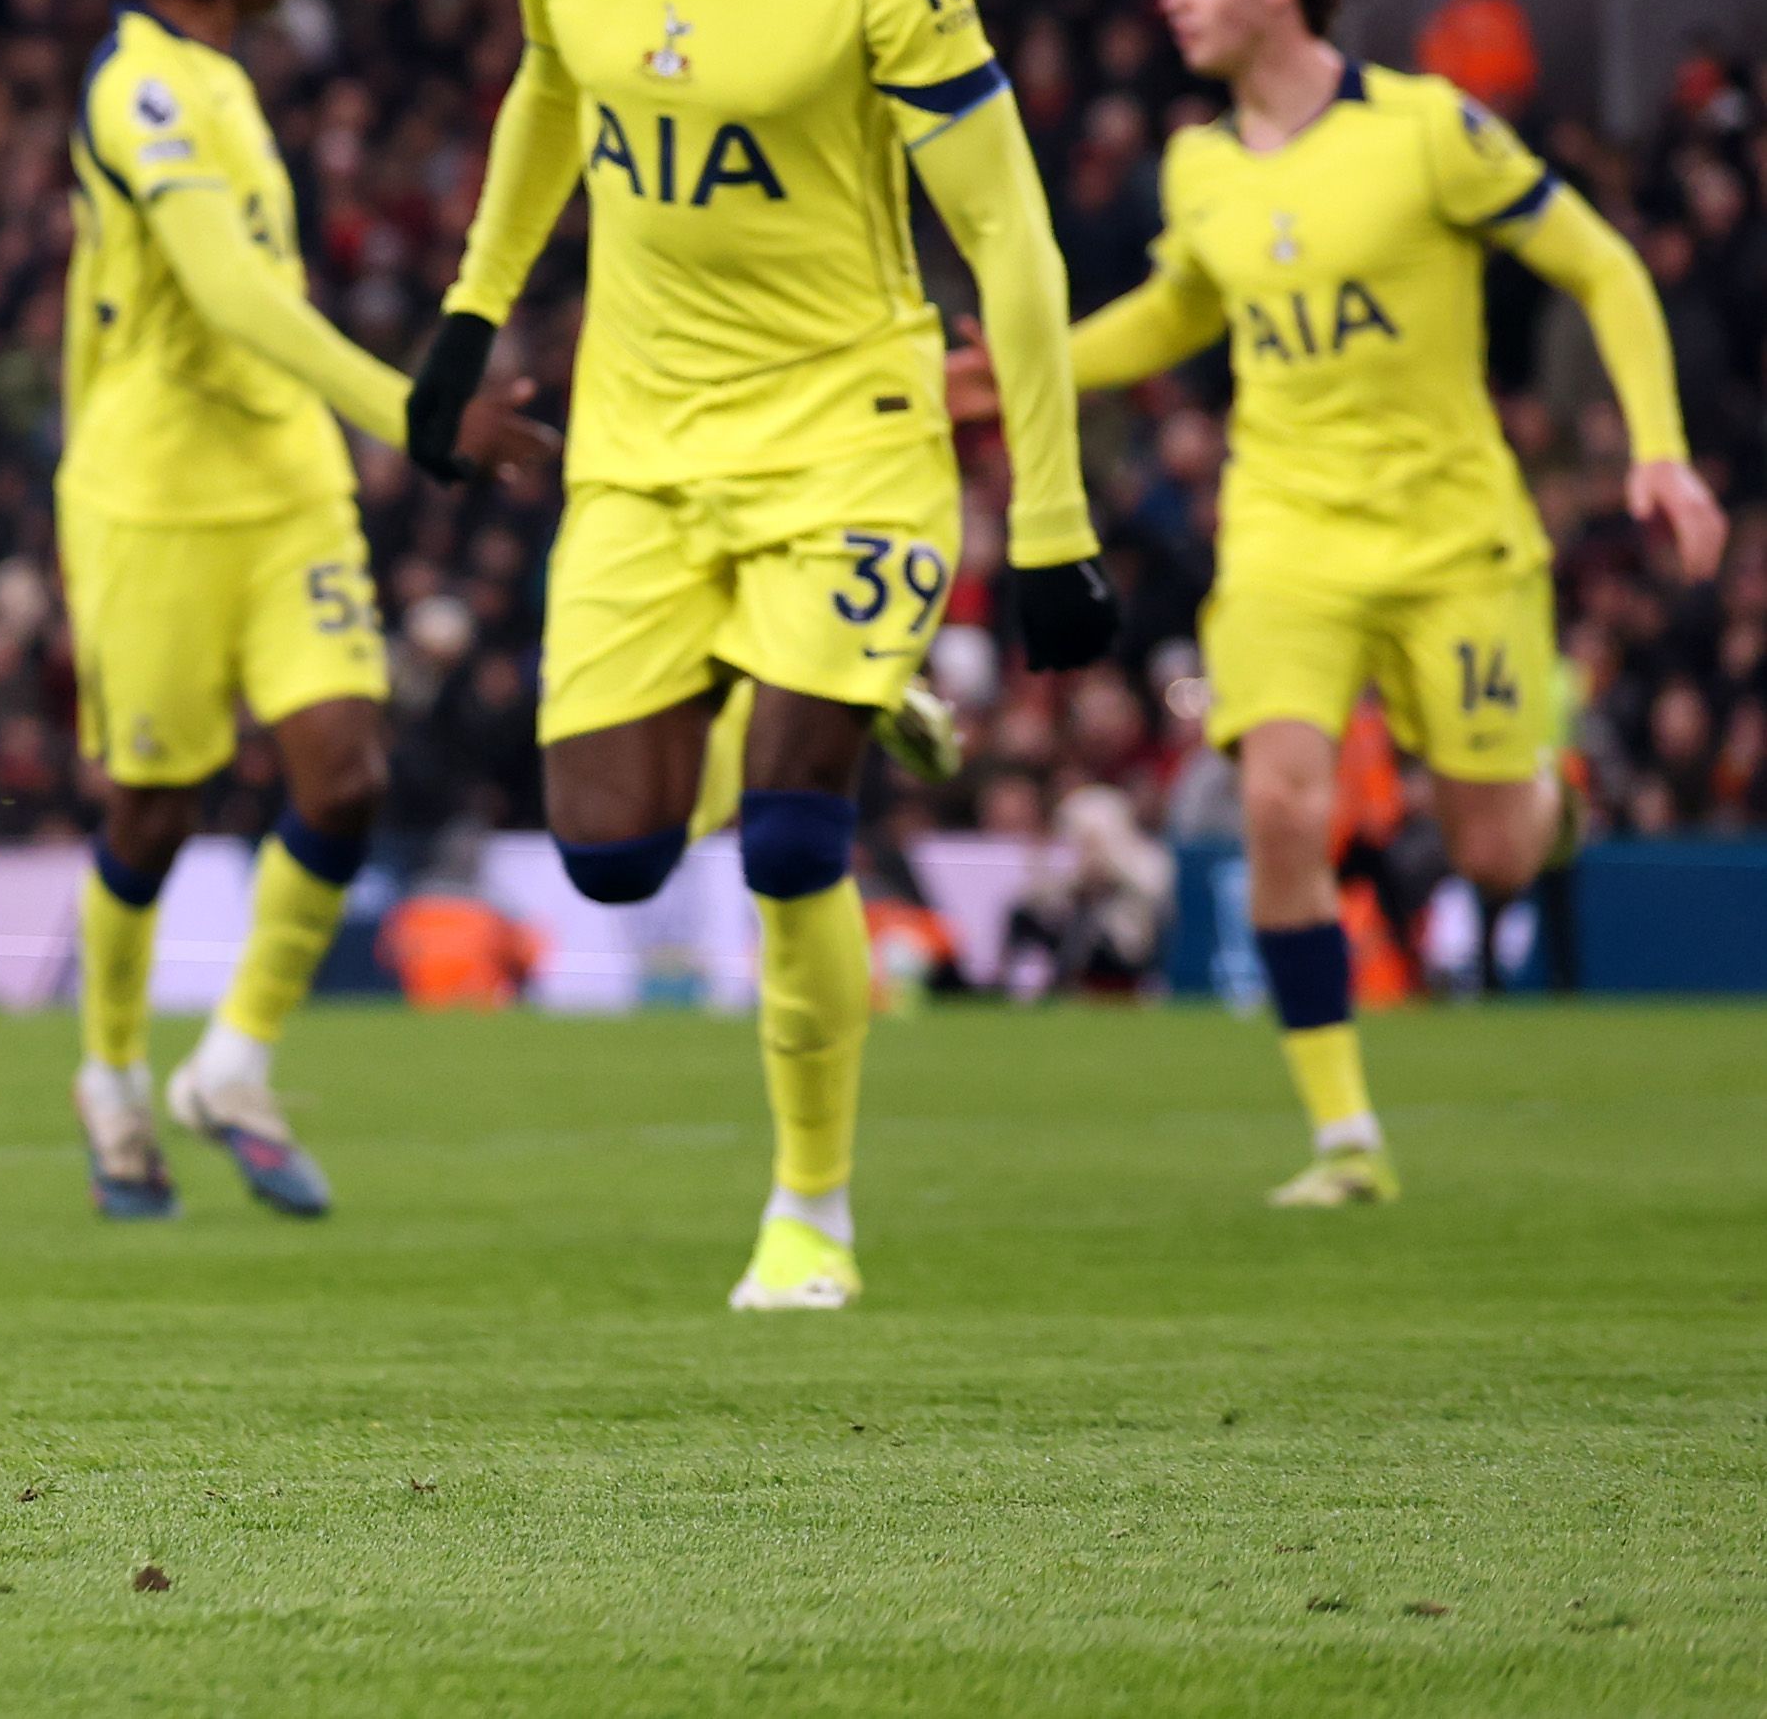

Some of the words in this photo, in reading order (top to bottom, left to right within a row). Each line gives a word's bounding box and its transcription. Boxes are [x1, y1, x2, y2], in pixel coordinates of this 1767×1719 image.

[591, 102, 786, 206] AIA
[1246, 278, 1400, 364] AIA
[833, 532, 946, 634] 39
[1456, 642, 1520, 713] 14
